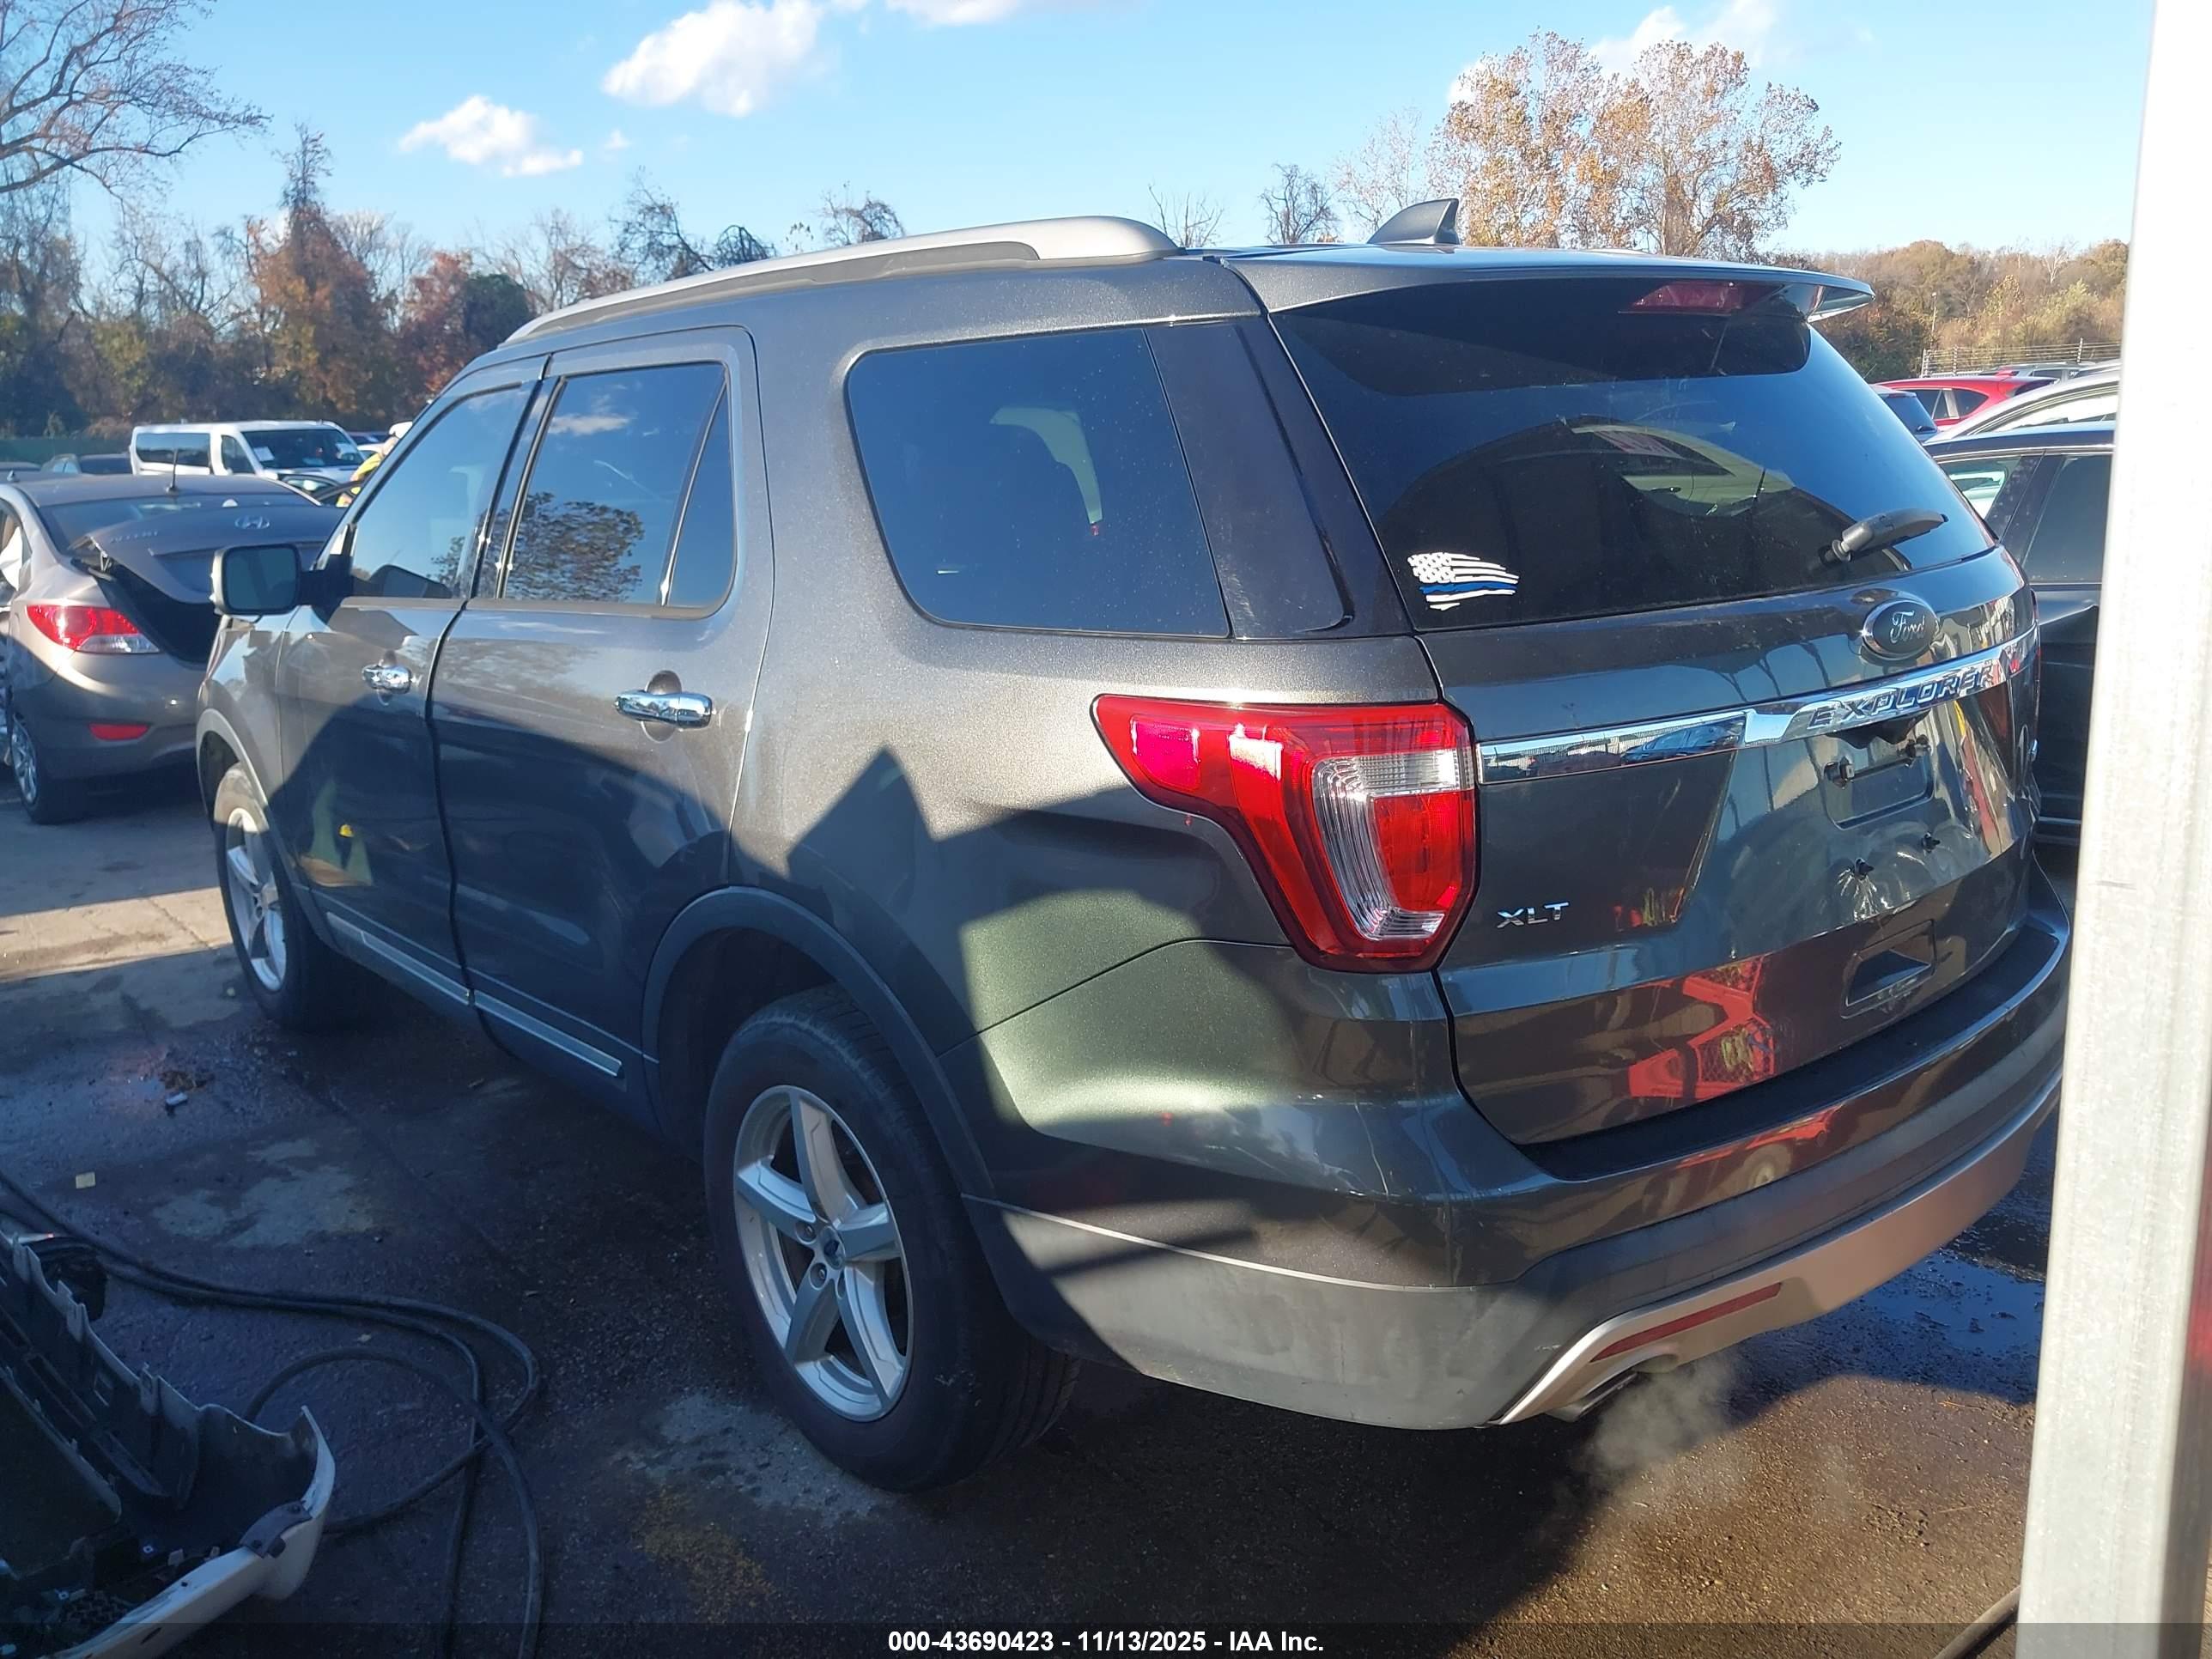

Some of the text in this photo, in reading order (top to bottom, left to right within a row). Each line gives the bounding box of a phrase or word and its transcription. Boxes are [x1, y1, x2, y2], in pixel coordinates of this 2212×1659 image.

[1889, 610, 1926, 644] Ford
[1806, 659, 1995, 730] EXPLORER
[1497, 902, 1570, 928] XLT
